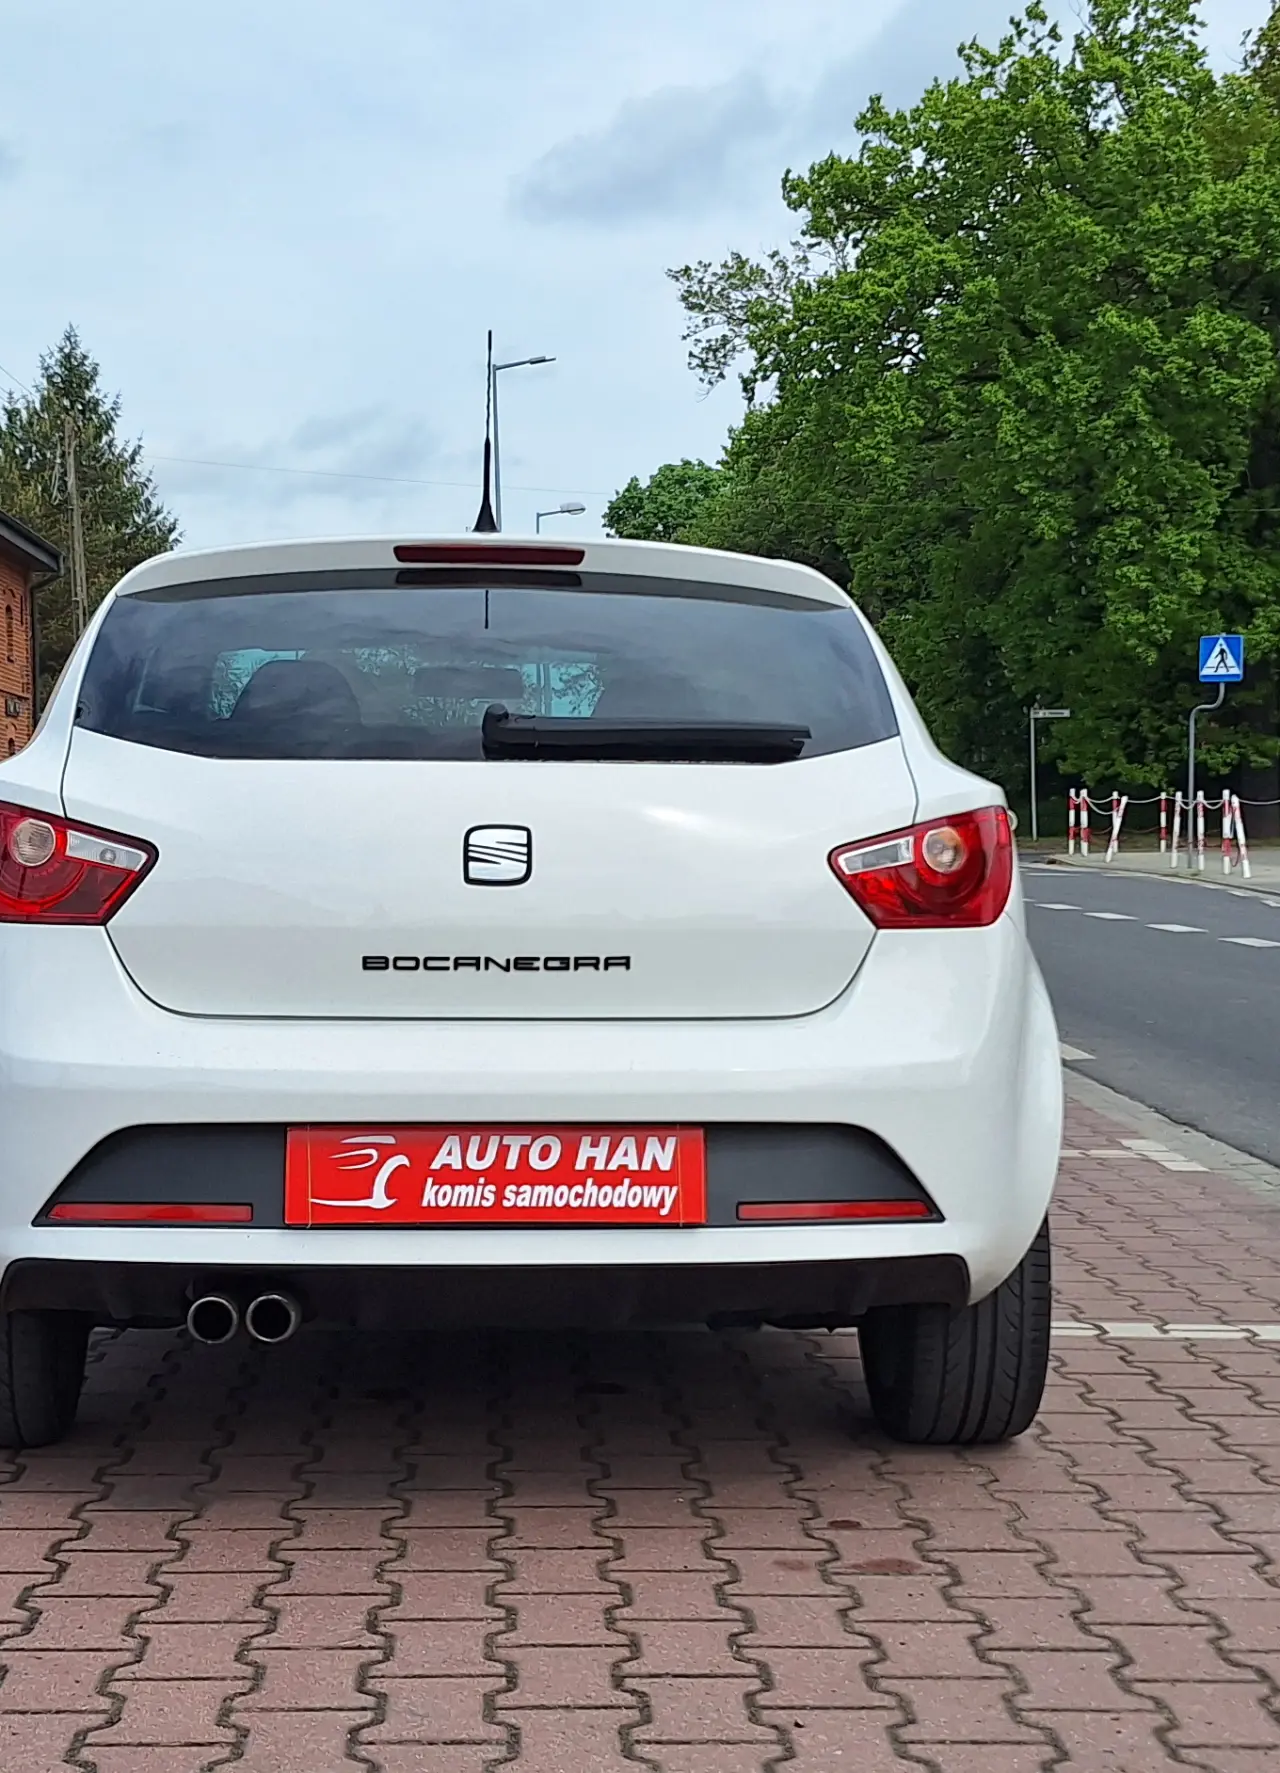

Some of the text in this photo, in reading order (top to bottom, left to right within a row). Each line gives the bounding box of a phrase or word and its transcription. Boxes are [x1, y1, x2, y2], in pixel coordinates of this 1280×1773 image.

[361, 955, 632, 973] BOCANEGRA
[429, 1134, 678, 1171] AUTO HAN
[421, 1176, 679, 1216] komis samochodowy
